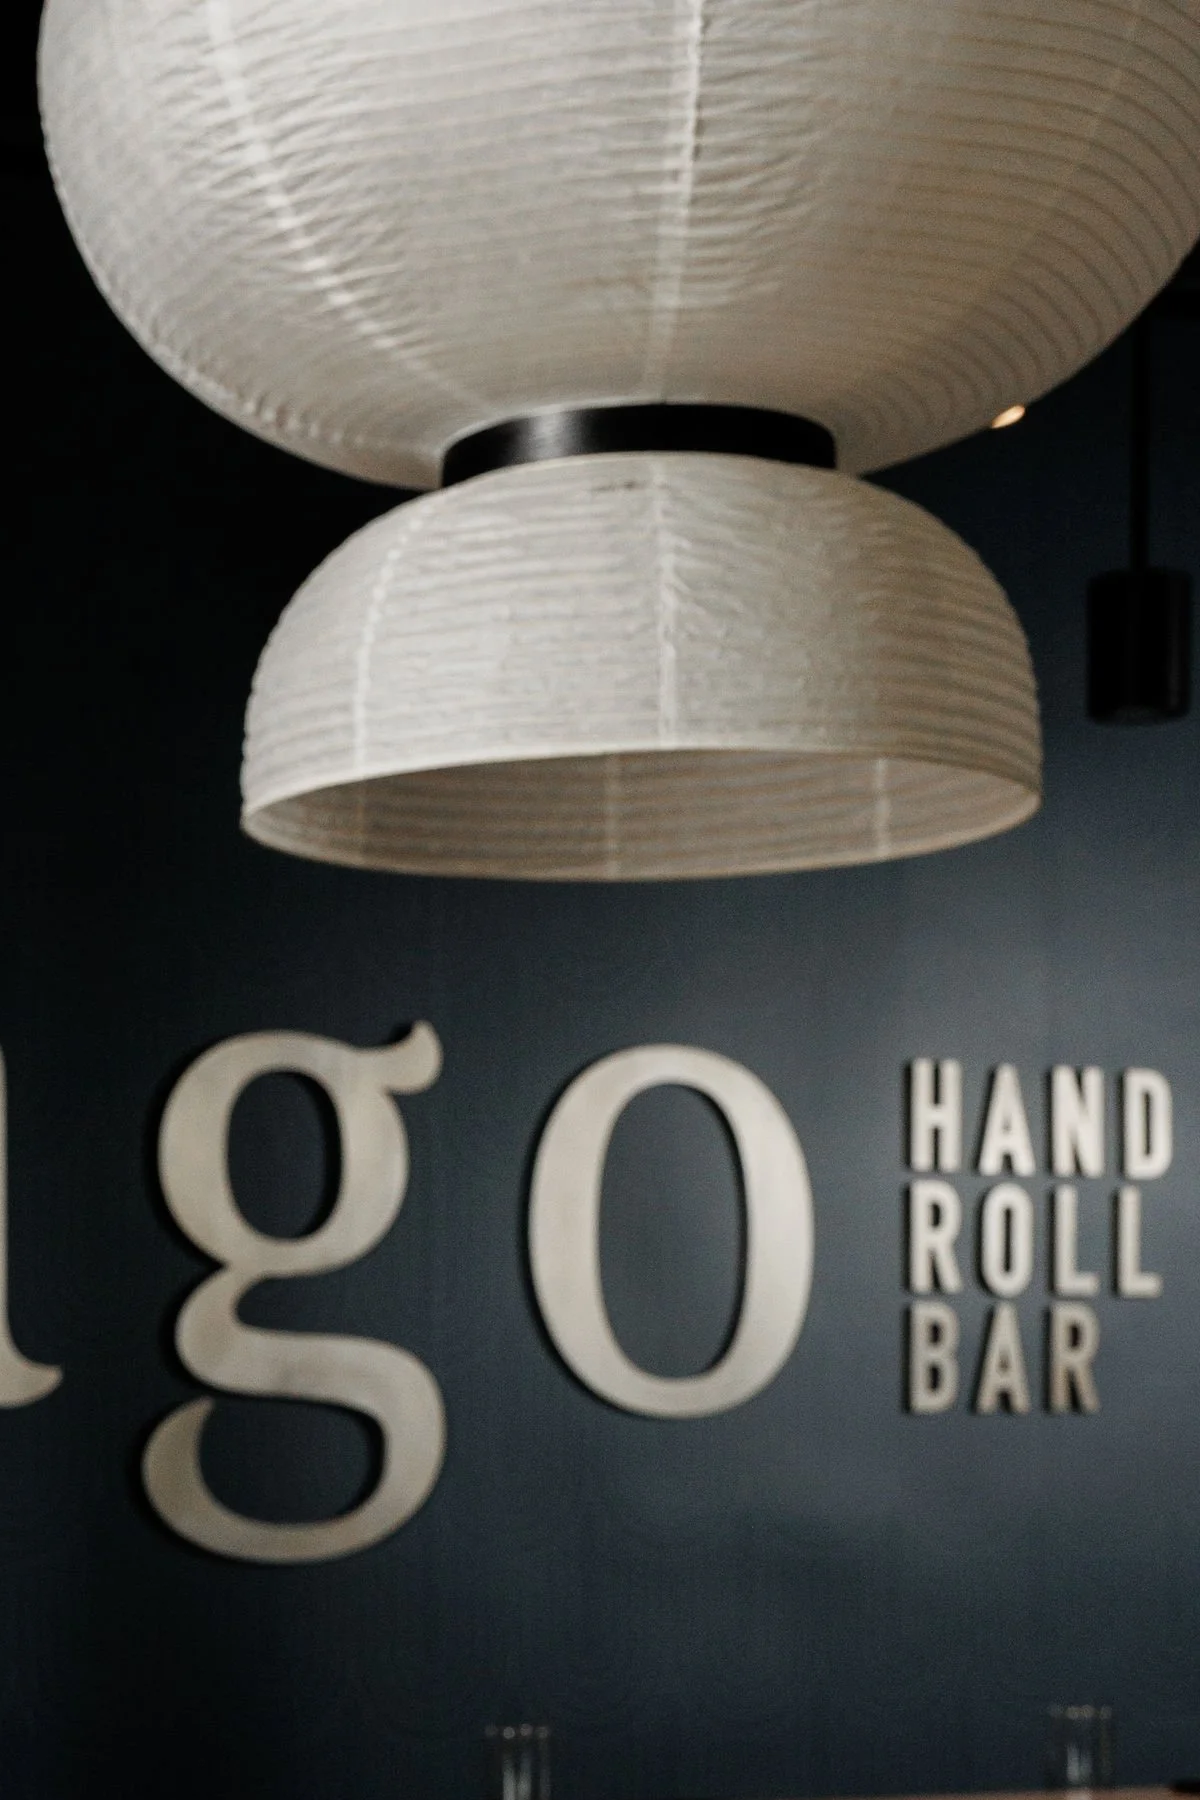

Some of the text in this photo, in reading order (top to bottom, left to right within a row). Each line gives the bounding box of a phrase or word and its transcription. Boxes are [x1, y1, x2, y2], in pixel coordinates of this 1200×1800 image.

[909, 1057, 1174, 1180] HAND
[909, 1179, 1163, 1299] ROLL
[908, 1302, 1100, 1414] BAR
